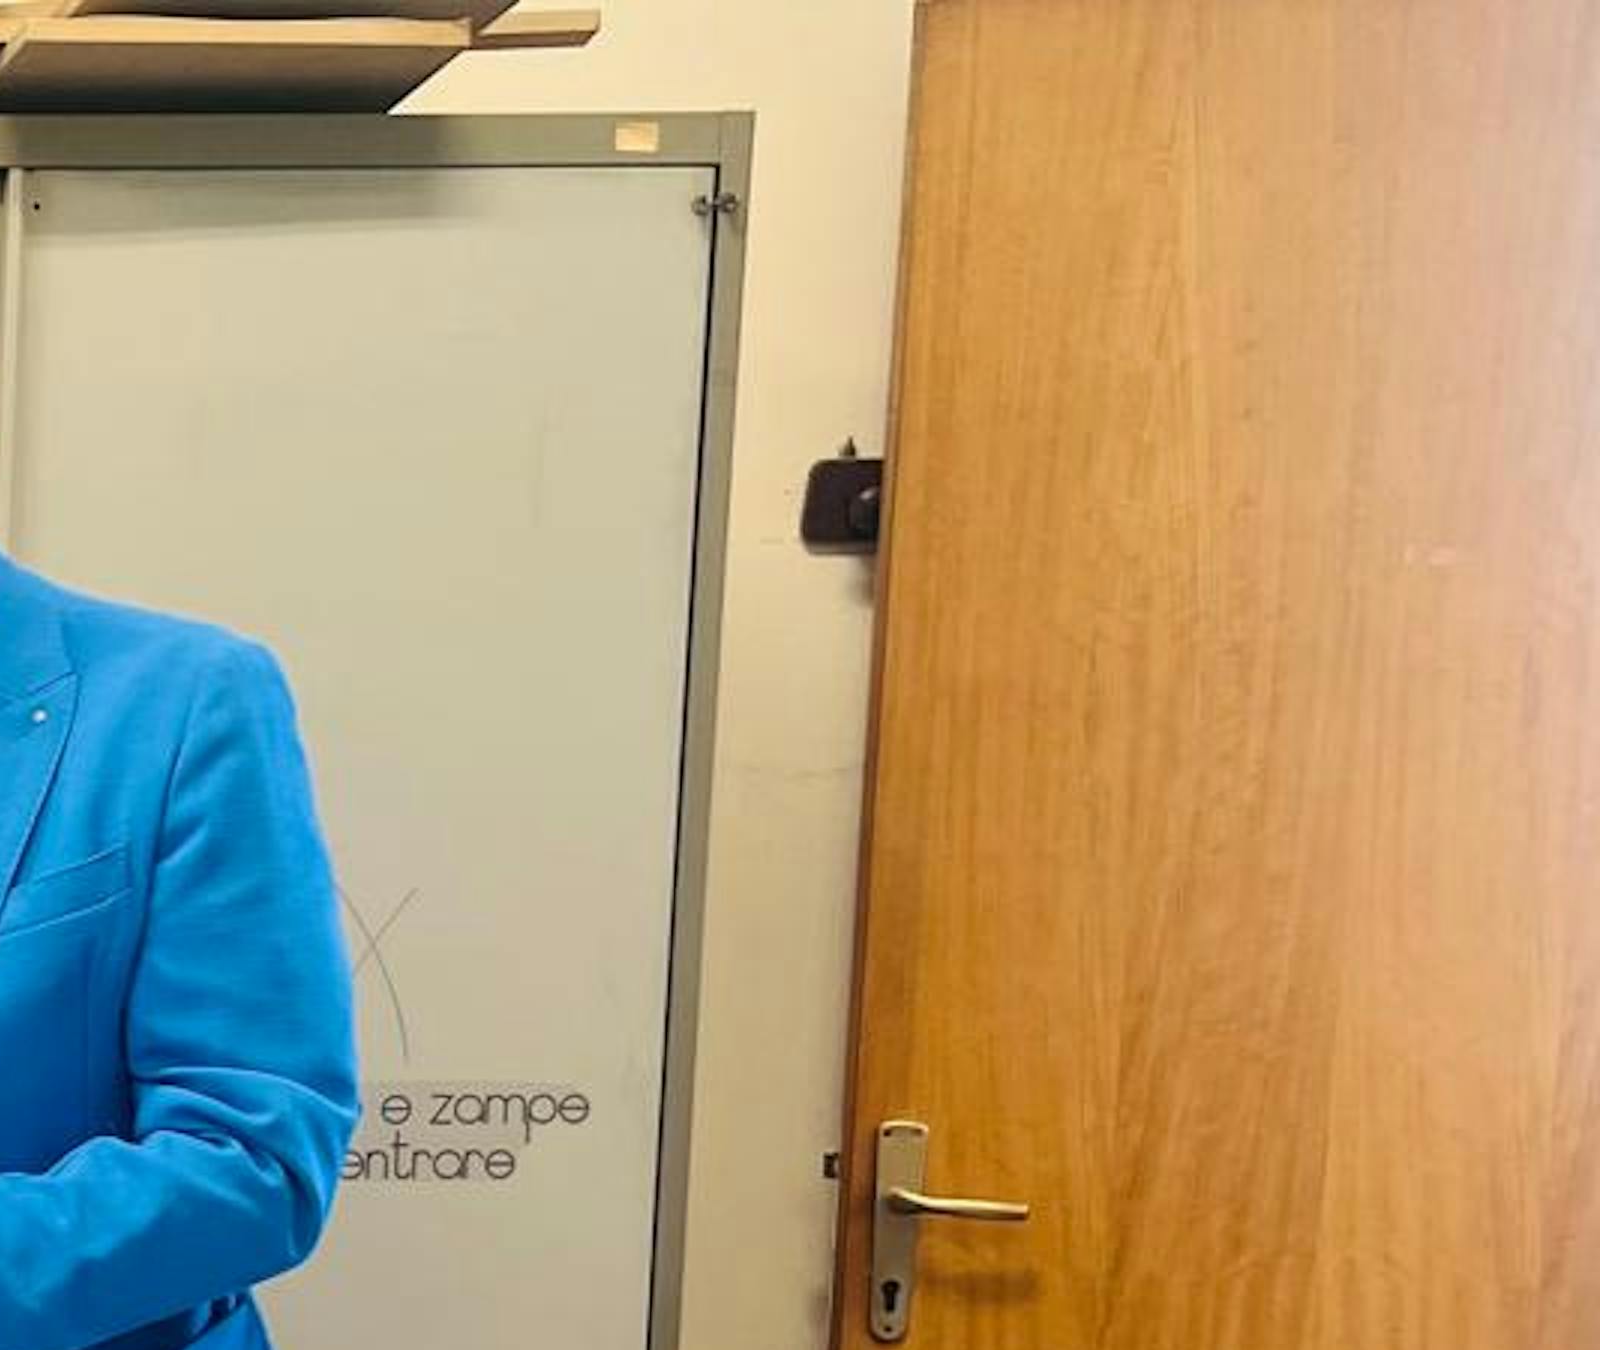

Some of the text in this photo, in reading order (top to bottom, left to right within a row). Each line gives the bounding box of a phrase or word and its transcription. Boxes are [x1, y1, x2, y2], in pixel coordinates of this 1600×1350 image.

[381, 1093, 590, 1144] e zampe
[340, 1130, 516, 1180] entrare
